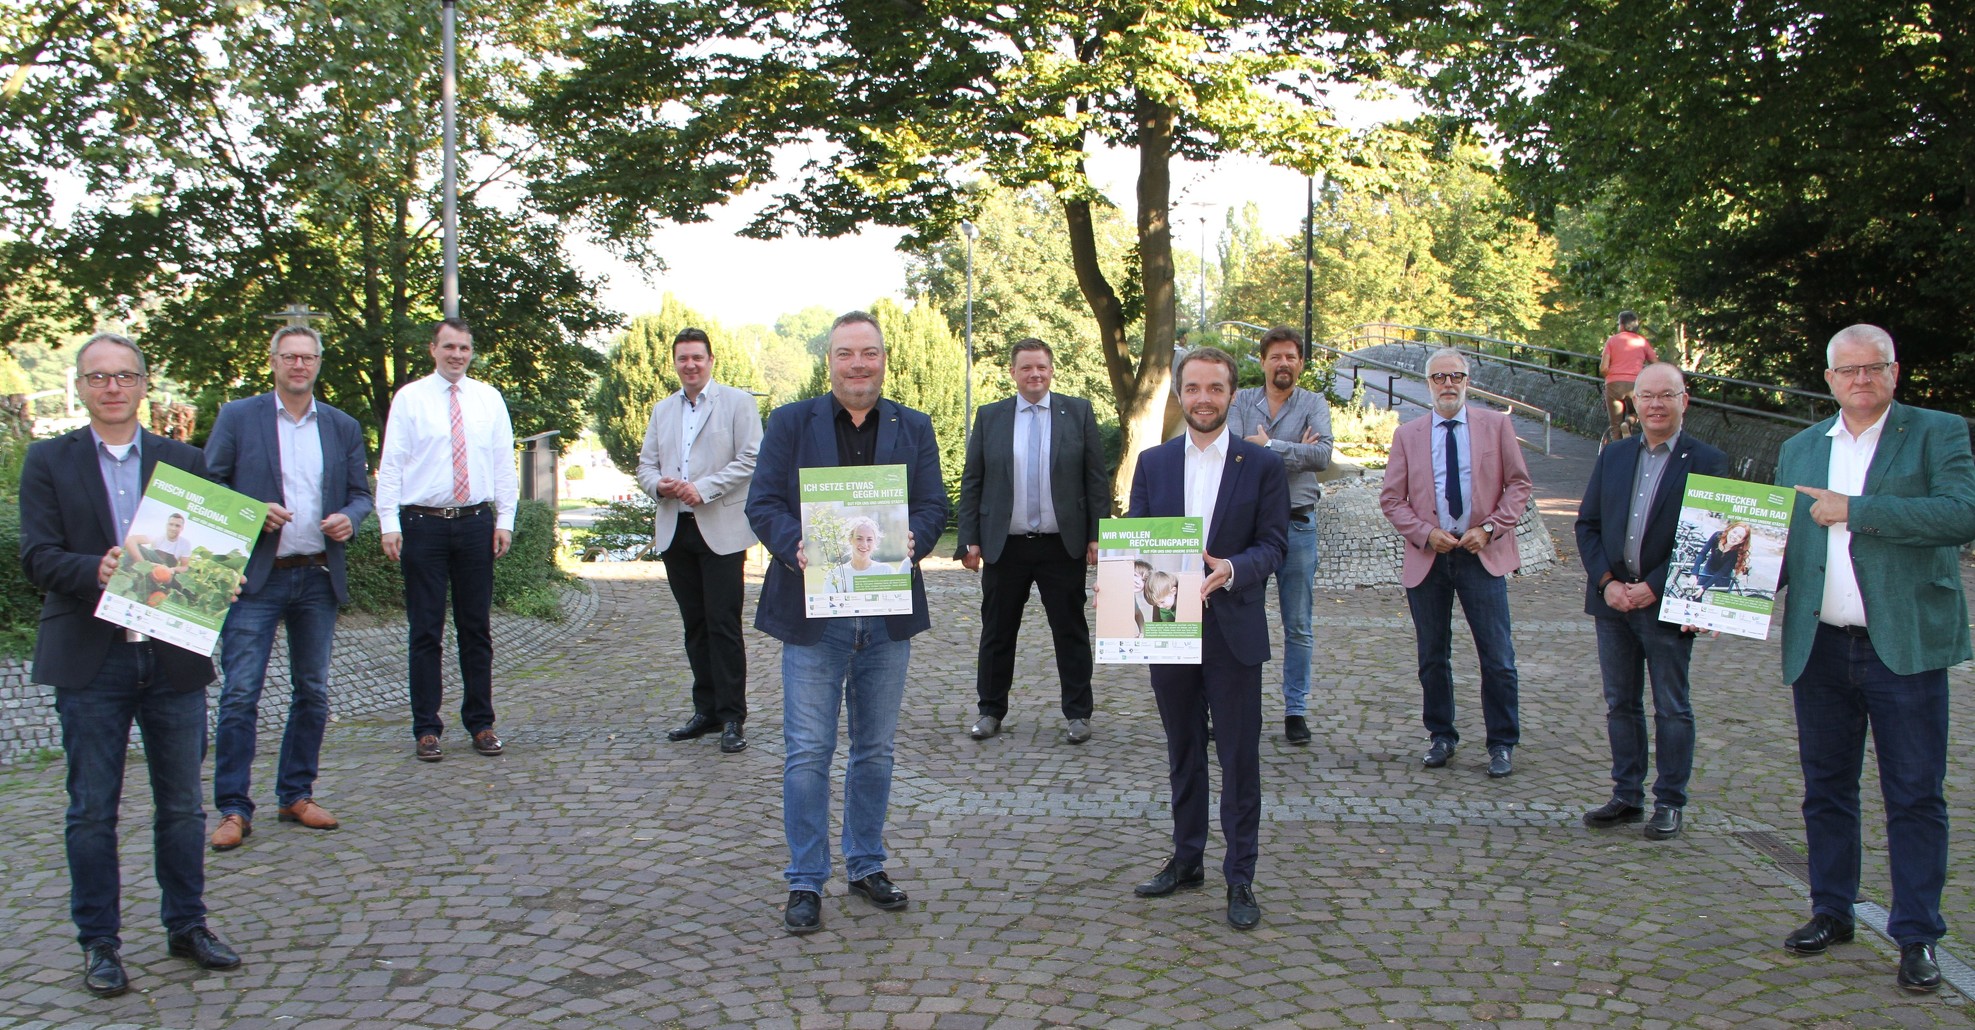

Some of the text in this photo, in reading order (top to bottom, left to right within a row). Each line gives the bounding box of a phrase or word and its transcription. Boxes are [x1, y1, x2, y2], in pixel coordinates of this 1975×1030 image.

[153, 479, 205, 504] FRISCH UND
[804, 481, 874, 492] ICH SETZE ETWAS
[853, 489, 904, 499] GEGEN HITZE
[1688, 489, 1713, 500] KURZE
[1715, 493, 1757, 506] STRECKEN
[187, 503, 228, 526] REGIONAL
[1732, 504, 1787, 520] MIT DEM RAD
[1102, 531, 1150, 540] WIR WOLLEN
[1130, 538, 1199, 547] RECYCLINGPAPIER
